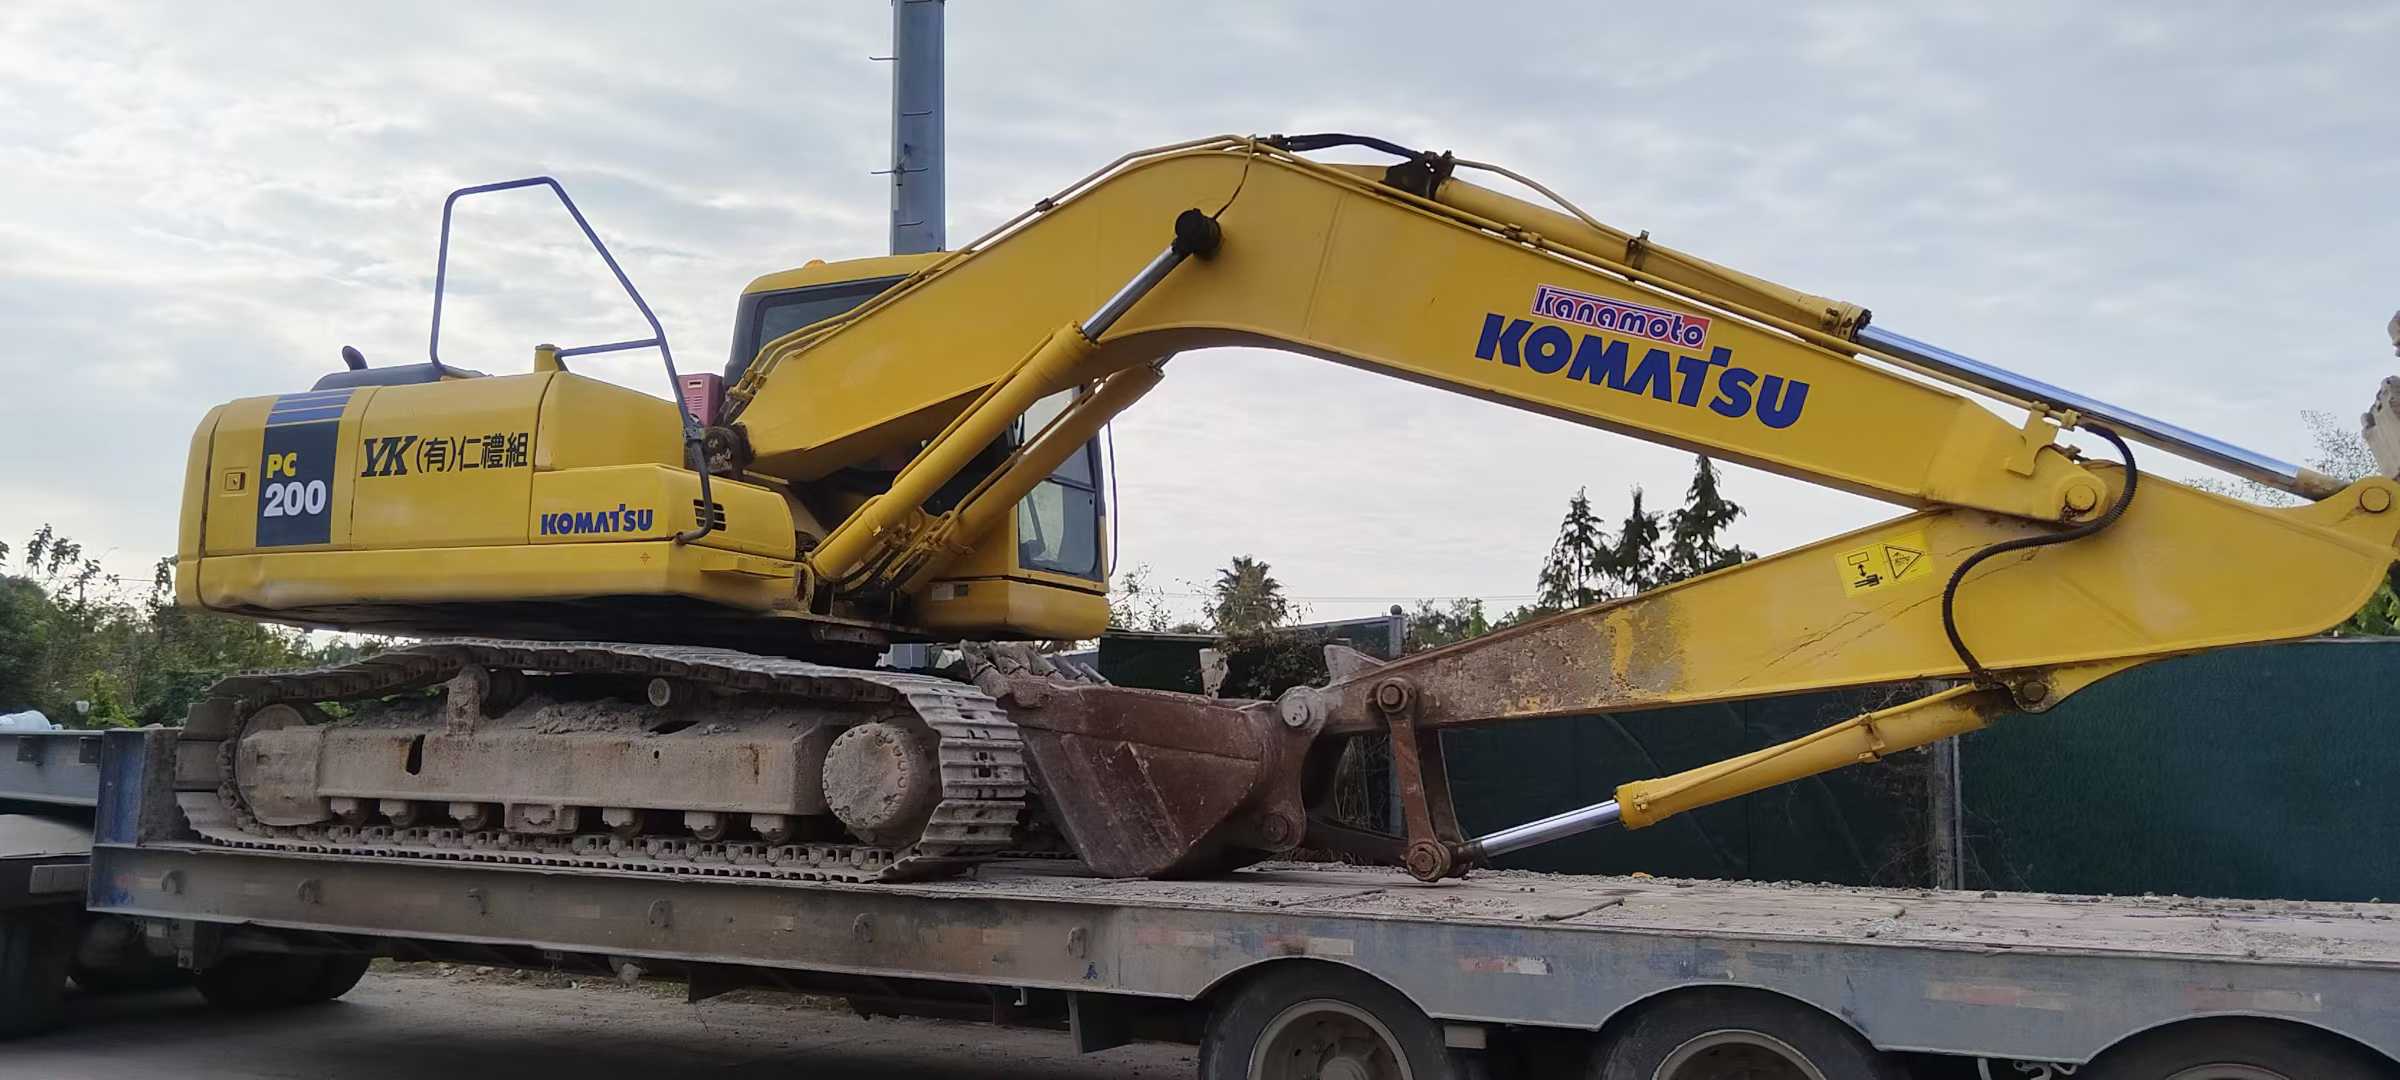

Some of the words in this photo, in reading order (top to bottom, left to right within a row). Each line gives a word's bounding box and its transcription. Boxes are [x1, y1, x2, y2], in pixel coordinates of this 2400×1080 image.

[1534, 286, 1706, 348] kanamoto
[1475, 313, 1810, 429] KOMATSU
[265, 452, 298, 479] PC
[360, 435, 418, 478] YK
[263, 480, 327, 517] 200
[541, 503, 654, 536] KOMATSU
